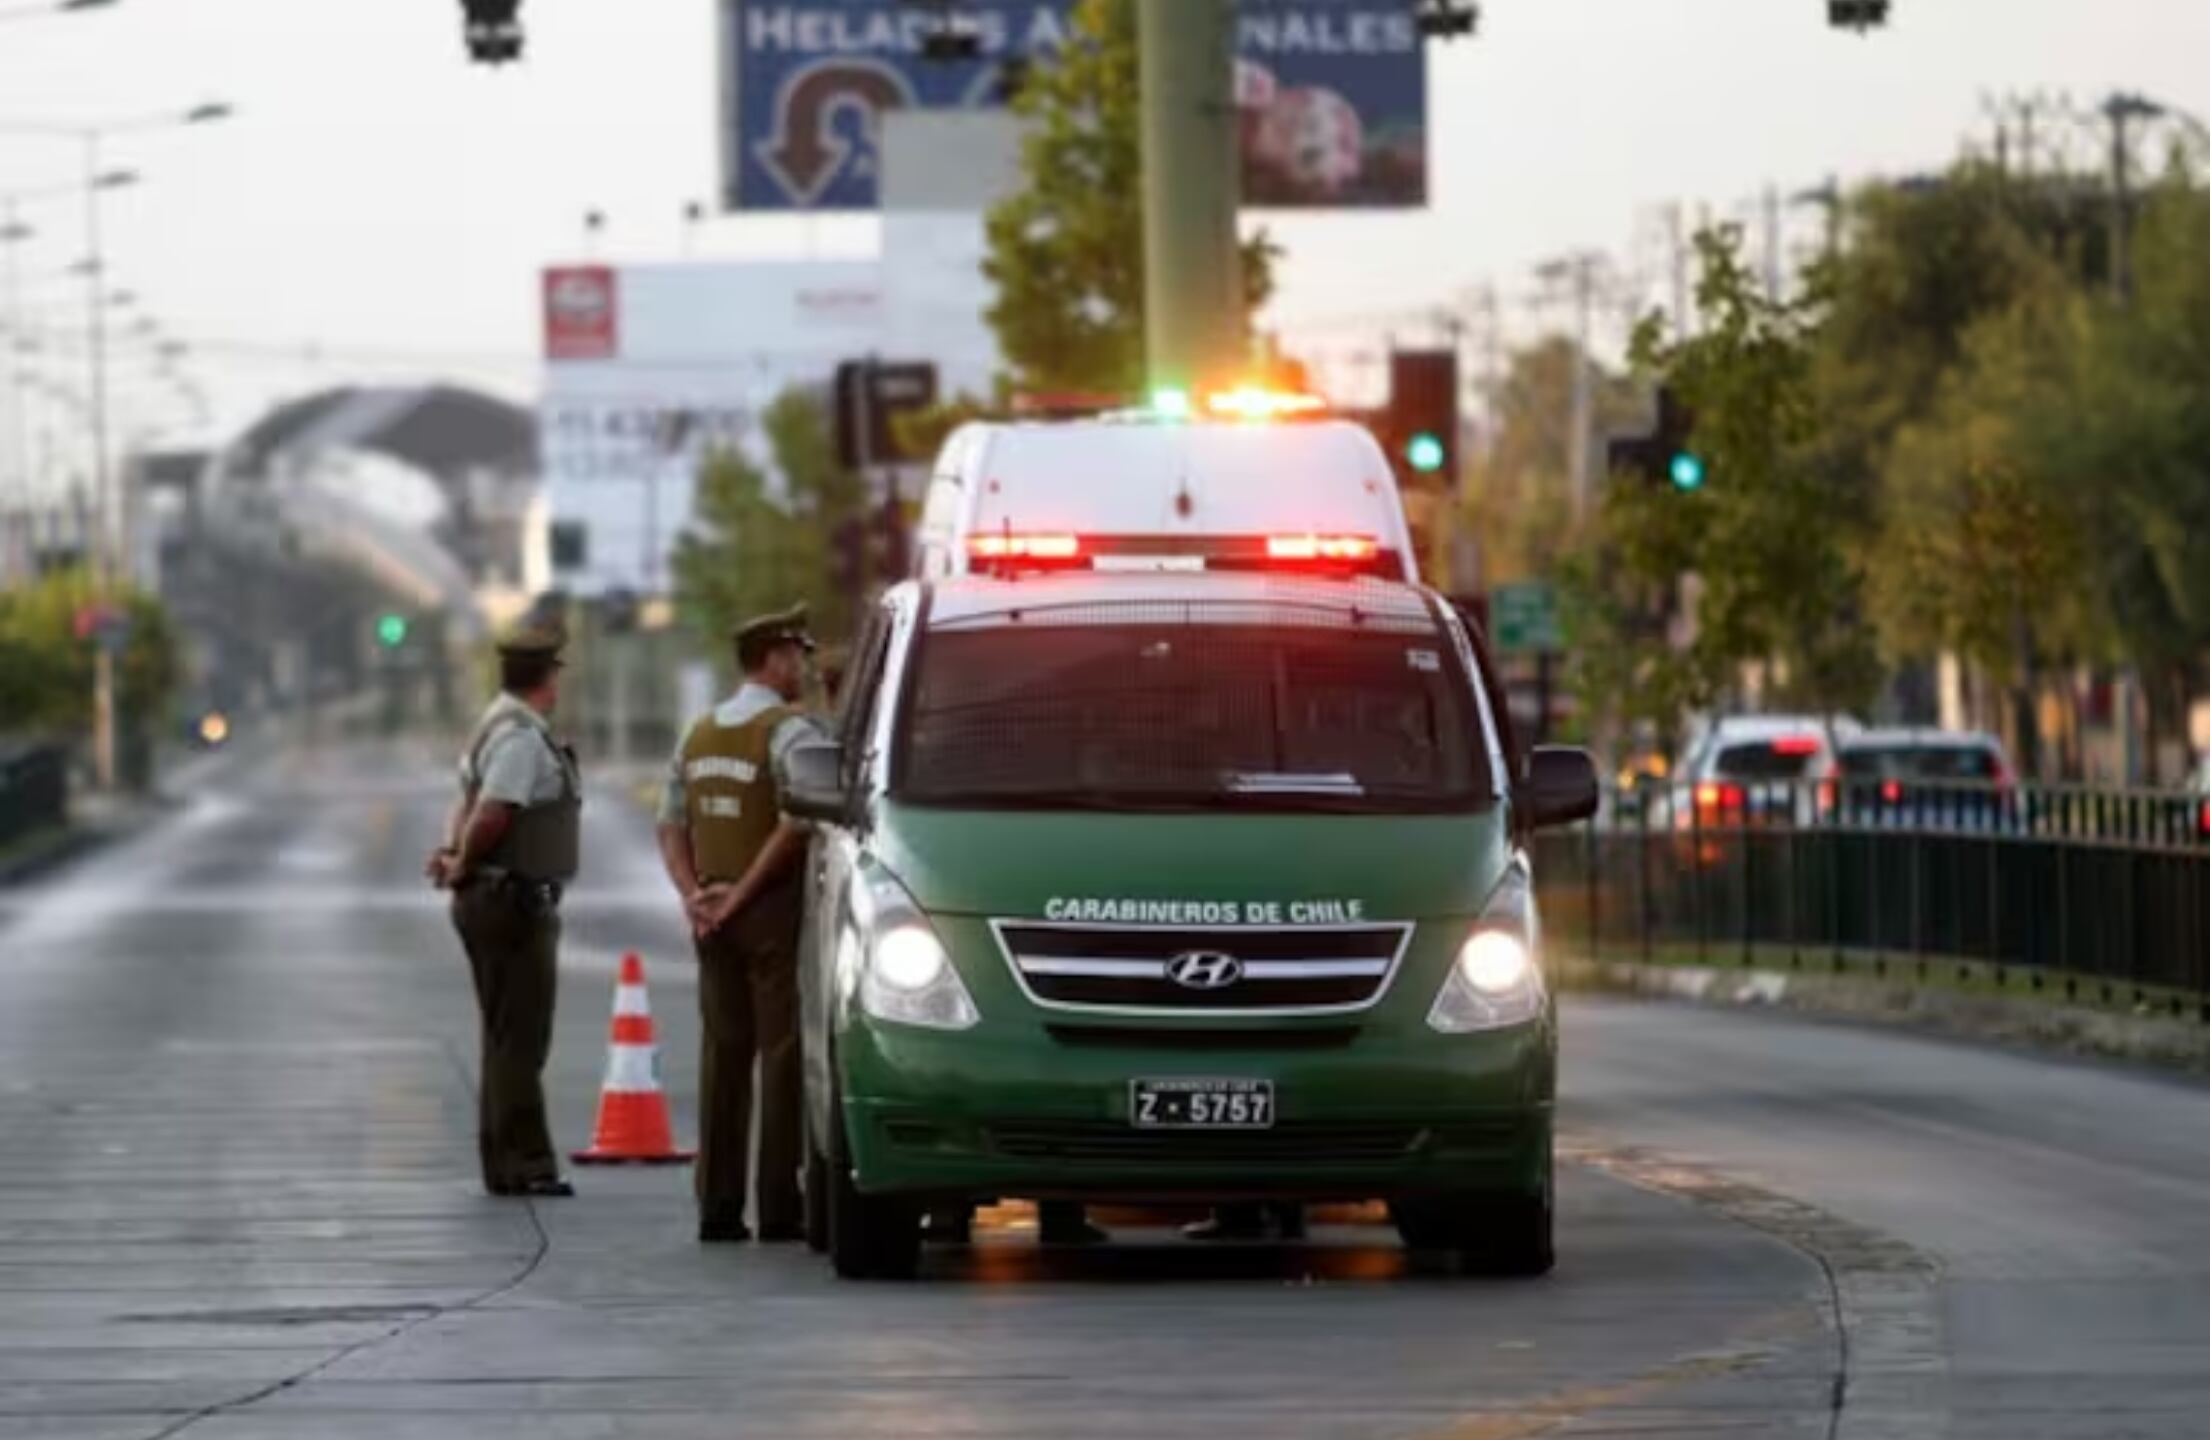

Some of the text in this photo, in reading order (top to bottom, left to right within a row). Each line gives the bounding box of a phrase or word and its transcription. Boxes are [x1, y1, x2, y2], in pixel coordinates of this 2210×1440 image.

[1045, 898, 1363, 924] CARABINEROS DE CHILE
[1138, 1093, 1158, 1122] Z
[1190, 1093, 1267, 1122] 5757
